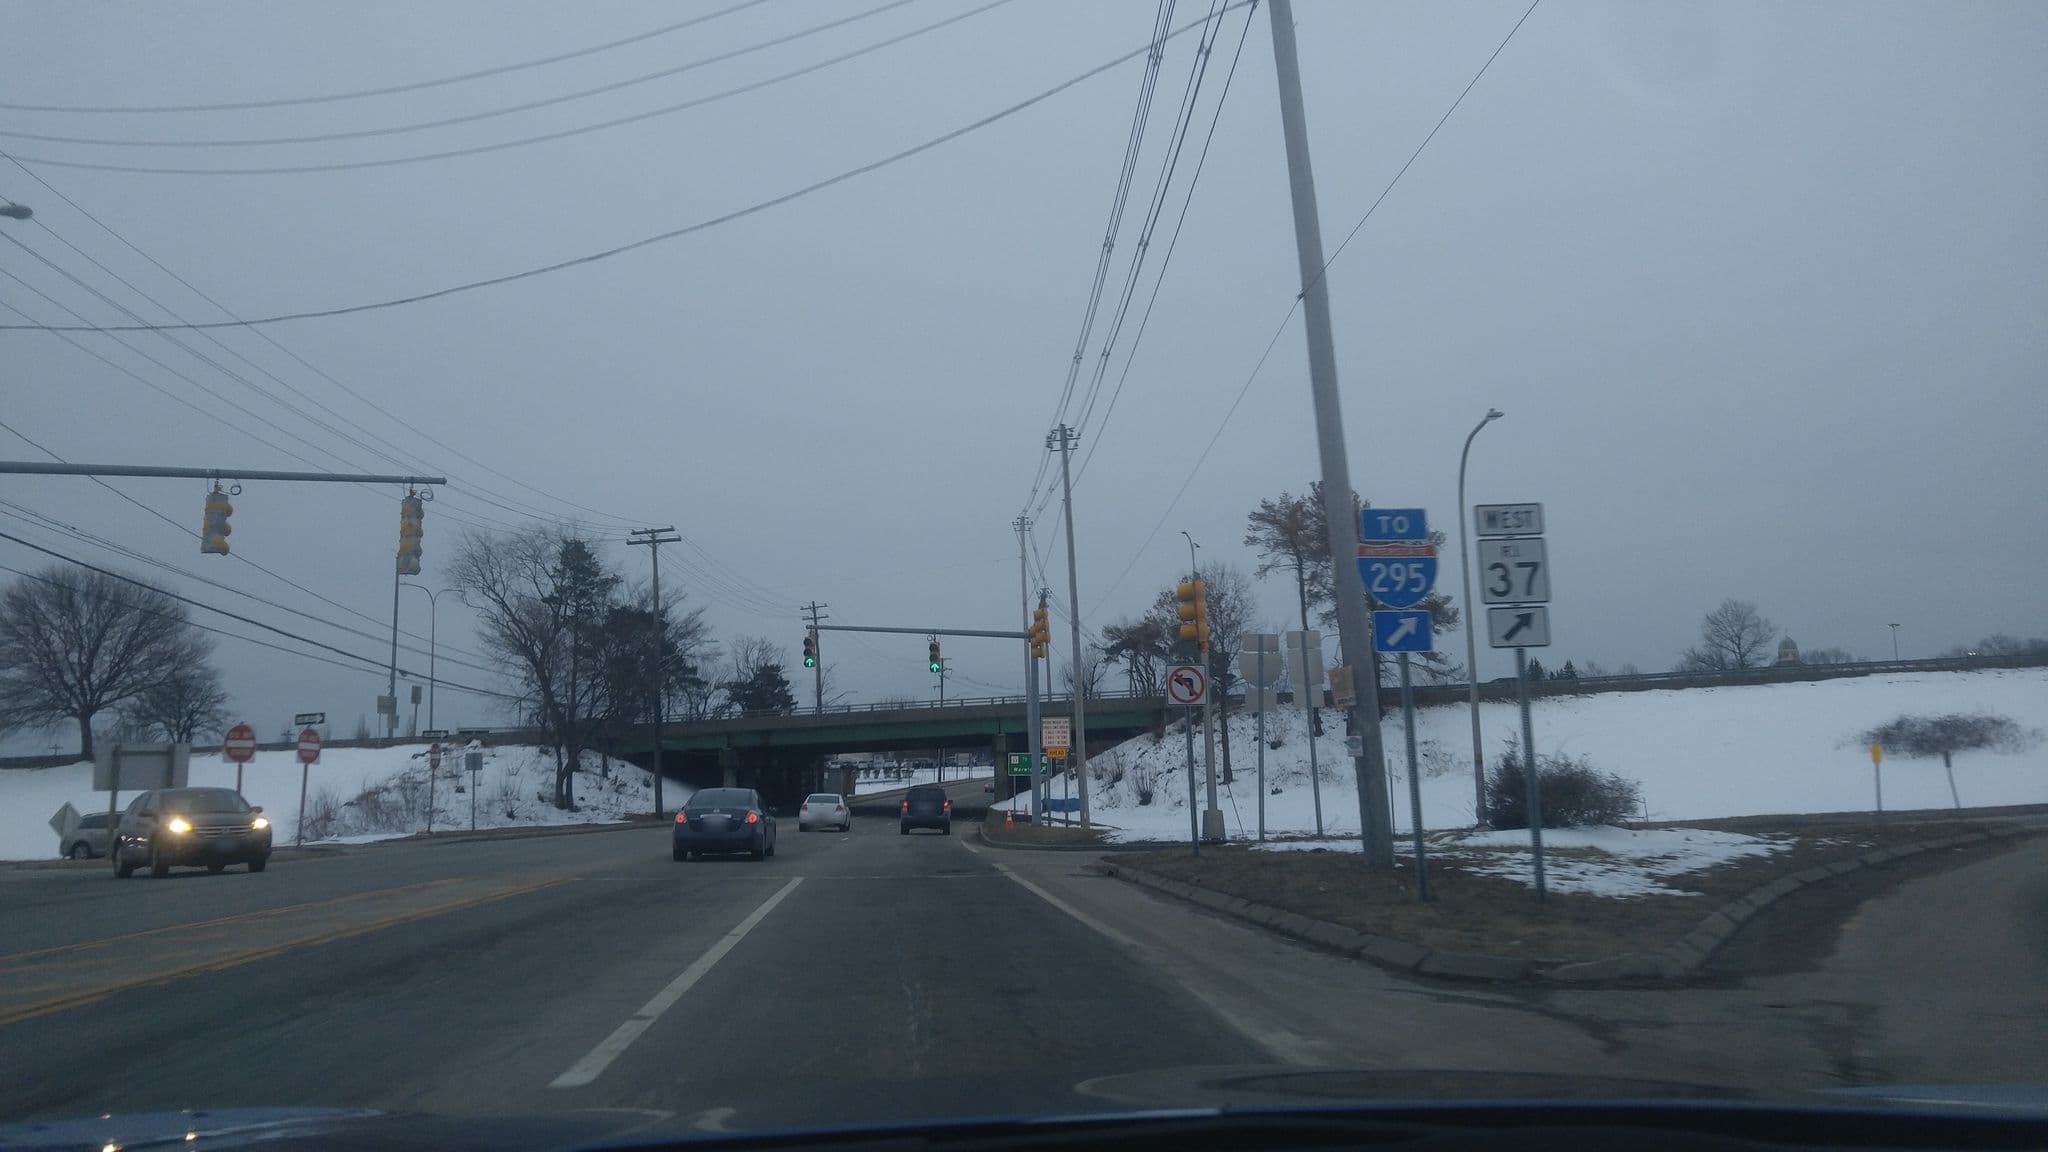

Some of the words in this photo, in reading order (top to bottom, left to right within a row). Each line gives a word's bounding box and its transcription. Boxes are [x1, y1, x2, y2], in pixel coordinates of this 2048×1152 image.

[1376, 515, 1410, 534] TO
[1483, 510, 1535, 529] WEST
[1369, 562, 1427, 593] 295
[1487, 561, 1541, 597] 37
